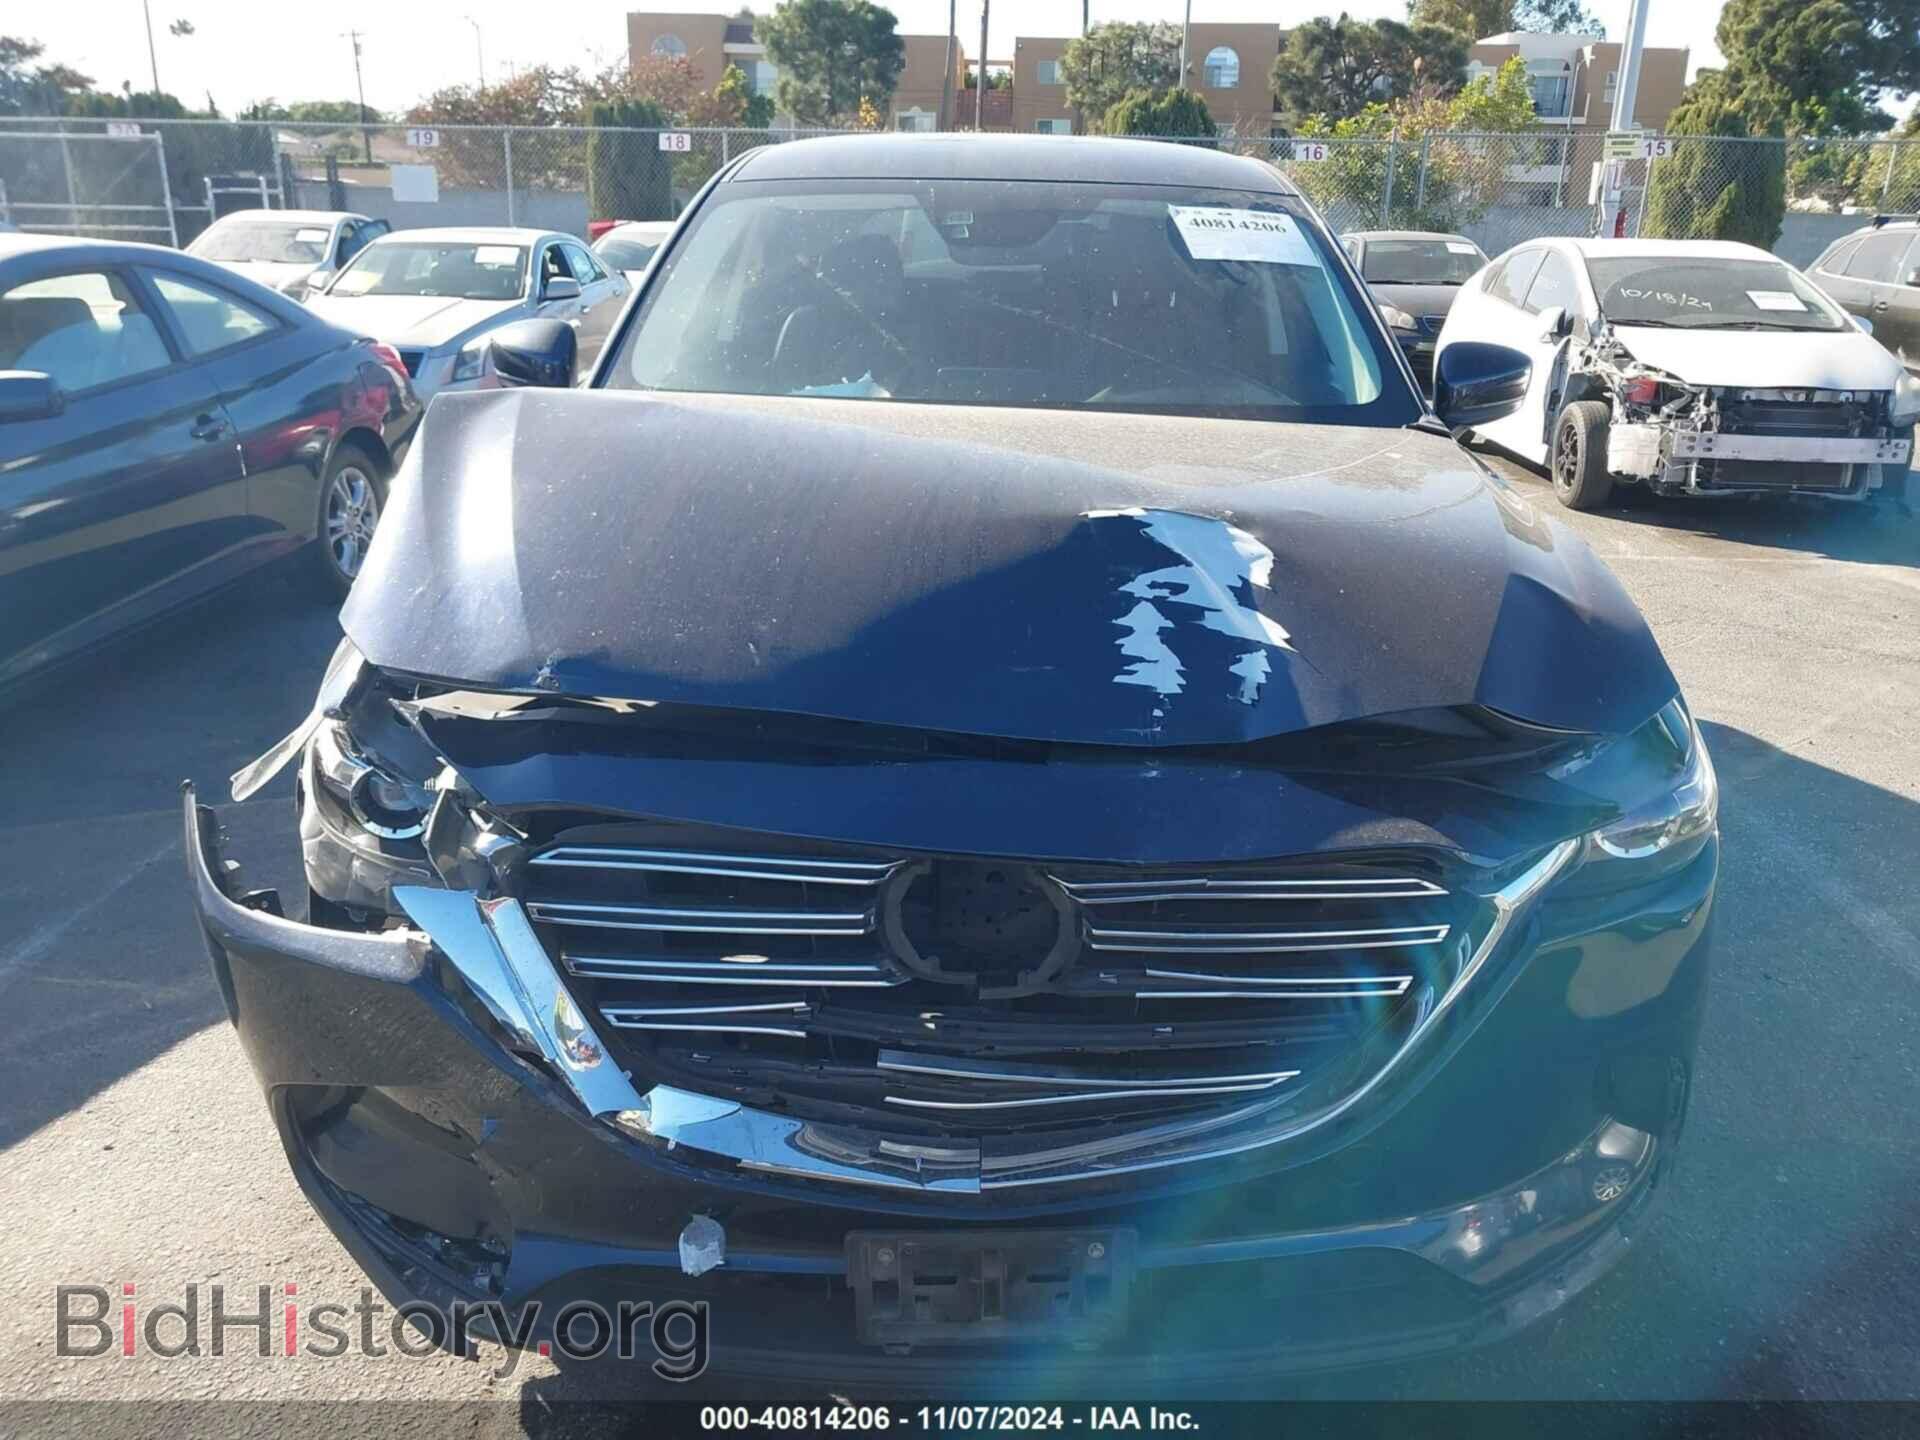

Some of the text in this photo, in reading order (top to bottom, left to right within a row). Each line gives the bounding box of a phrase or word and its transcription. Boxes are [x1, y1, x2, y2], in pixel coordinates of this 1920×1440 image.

[415, 131, 433, 145] 19
[665, 135, 685, 149] 18
[1303, 146, 1323, 160] 16
[1645, 142, 1666, 156] 15
[1190, 218, 1287, 233] 40814206
